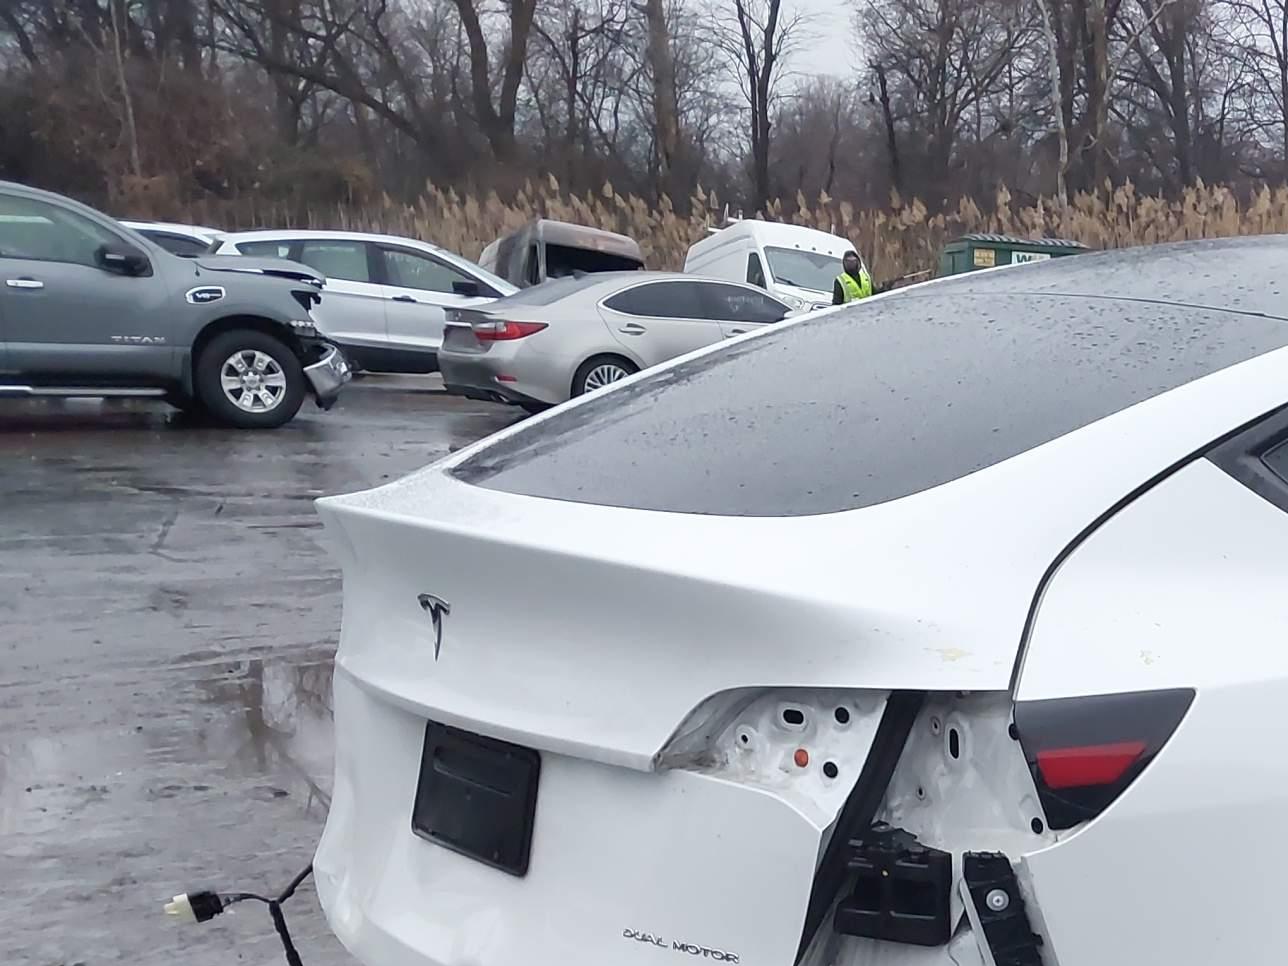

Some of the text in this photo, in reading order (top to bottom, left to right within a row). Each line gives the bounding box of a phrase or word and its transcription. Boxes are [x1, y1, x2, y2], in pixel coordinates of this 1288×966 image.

[110, 335, 166, 344] TITAN
[622, 928, 740, 965] DUAL MOTOR
